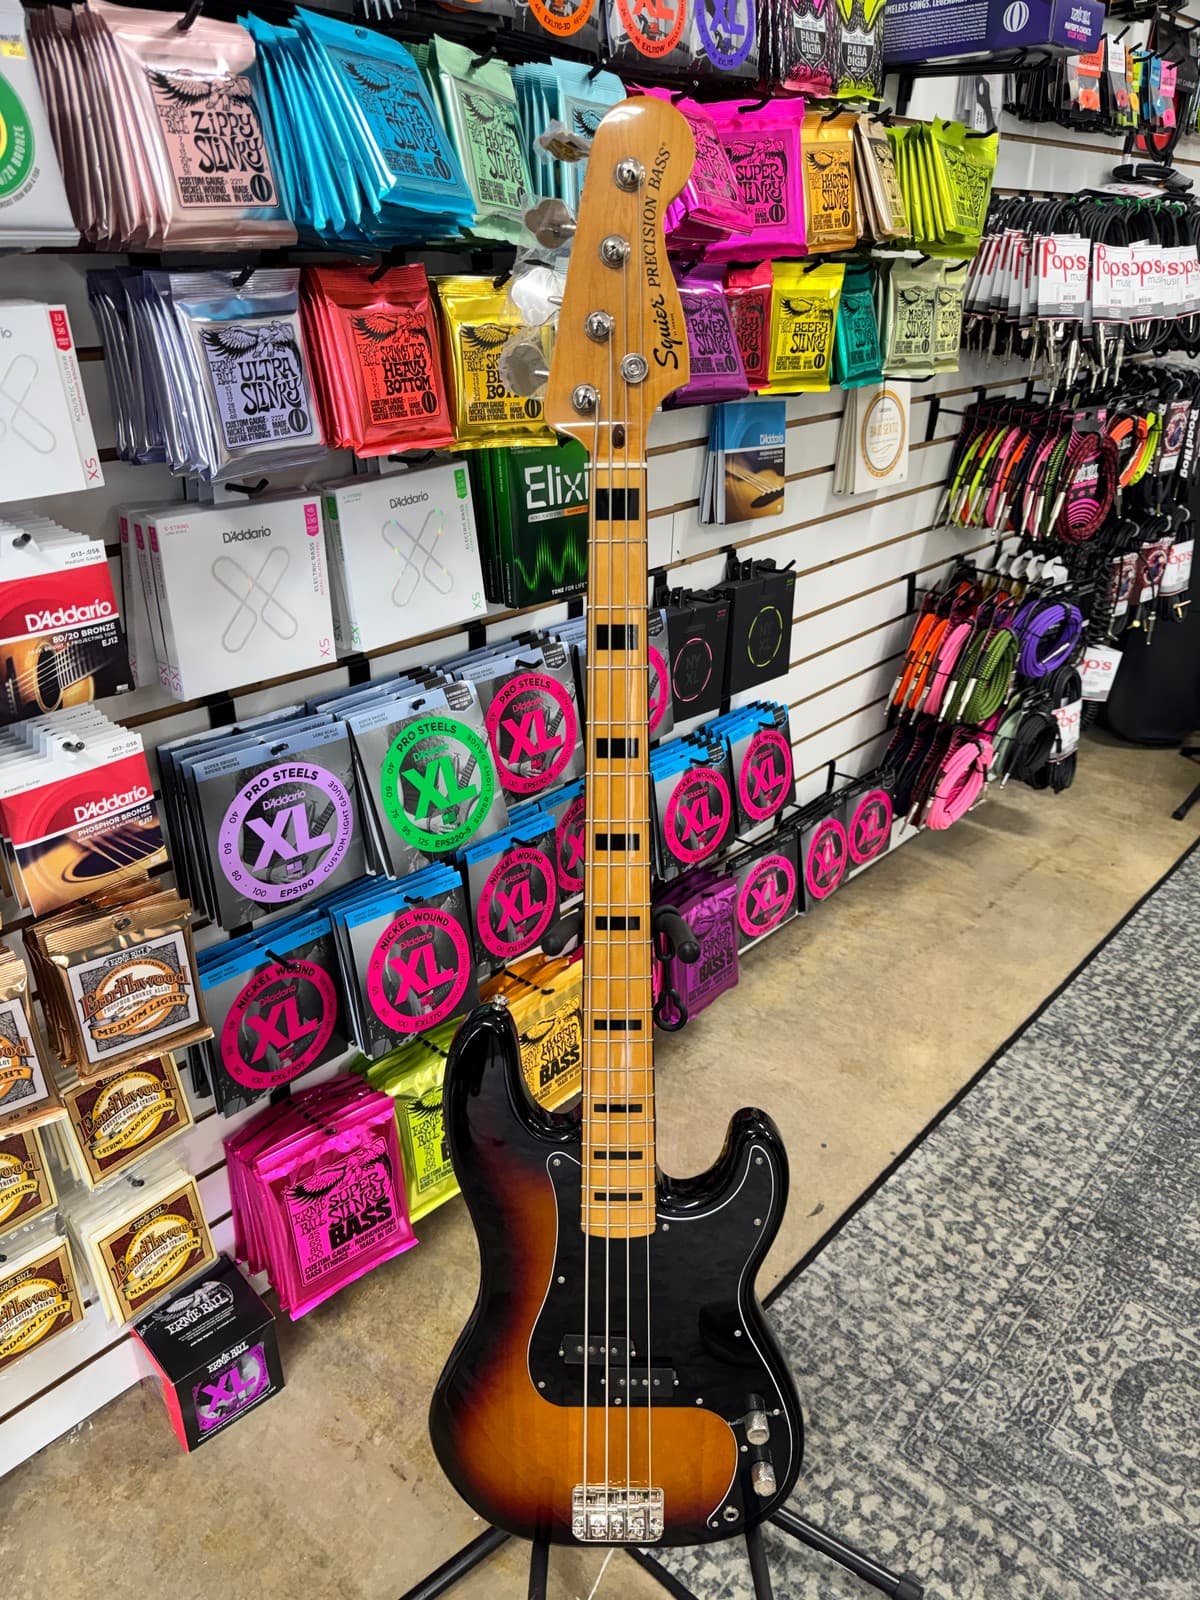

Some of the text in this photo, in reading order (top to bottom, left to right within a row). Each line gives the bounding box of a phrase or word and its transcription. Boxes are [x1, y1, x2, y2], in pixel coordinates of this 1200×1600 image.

[800, 31, 821, 43] PARA
[801, 43, 822, 54] DIGM
[847, 45, 868, 57] PARA
[847, 56, 868, 67] DIGM
[643, 146, 671, 287] PRECISION BASS
[652, 293, 683, 369] Squier
[691, 318, 729, 333] POWER
[793, 322, 828, 333] BEEFY
[410, 343, 425, 360] TOP
[238, 356, 297, 381] ULTRA
[383, 359, 428, 379] HEAVY
[385, 375, 433, 396] BOTTOM
[225, 415, 267, 430] CUSTOM GAUGE
[272, 420, 287, 428] MADE
[84, 457, 100, 481] XS
[389, 490, 429, 510] D'Addario
[222, 525, 272, 544] D'Addario
[312, 563, 320, 593] ELECTRIC
[551, 583, 586, 596] TONE FOR LIFE
[471, 591, 482, 610] XS
[25, 599, 112, 633] D'Addario
[52, 622, 116, 645] 80/20 BRONZE
[101, 637, 119, 649] EJ12
[319, 637, 331, 658] XS
[499, 678, 553, 705] PRO STEELS
[396, 721, 458, 754] PRO STEELS
[501, 708, 562, 766] XL
[243, 767, 319, 801] PRO STEELS
[400, 754, 479, 822] XL
[673, 771, 719, 801] NICKEL WOUND
[751, 756, 785, 800] XL
[73, 786, 148, 823] D'Addario
[261, 789, 306, 811] D'Addario
[77, 803, 152, 837] PHOSPHOR BRONZE
[138, 814, 153, 826] EJ17
[323, 780, 351, 873] CUSTOM LIGHT GAUGE
[679, 795, 722, 842] XL
[858, 810, 884, 849] XL
[244, 802, 333, 874] XL
[434, 825, 472, 849] EPS220-5
[223, 810, 267, 898] 40 60 80 100
[489, 851, 544, 886] NICKEL WOUND
[753, 859, 782, 877] CHROMES
[815, 842, 841, 882] XL
[279, 878, 315, 899] EPS190
[751, 879, 786, 921] XL
[495, 878, 544, 935] XL
[380, 912, 449, 951] NICKEL WOUND
[399, 931, 433, 951] D'Addario
[389, 943, 456, 1007] XL
[79, 964, 192, 1025] Earthwood
[236, 973, 273, 1011] NICKEL
[258, 984, 297, 1008] D'Addario
[97, 994, 187, 1038] MEDIUM LIGHT
[245, 995, 320, 1065] XL
[541, 1023, 578, 1055] HYBRID
[539, 1045, 581, 1088] BASS
[77, 1071, 177, 1146] Earthwood
[123, 1120, 141, 1141] BANJO
[411, 1114, 442, 1137] ERNIE
[417, 1127, 440, 1148] BALL
[328, 1171, 385, 1209] SUPER
[293, 1200, 327, 1226] ERNIE
[300, 1215, 328, 1237] BALL
[328, 1197, 393, 1251] BASS
[111, 1211, 203, 1289] Earthwood
[308, 1230, 320, 1241] 45
[308, 1238, 322, 1248] 65
[129, 1239, 199, 1297] MANDOLIN MEDIUM
[304, 1257, 332, 1275] CUSTOM
[332, 1243, 352, 1261] GAUGE
[305, 1236, 378, 1282] BASS STRINGS MADE
[307, 1252, 324, 1264] 100
[38, 1303, 68, 1323] LIGHT
[164, 1307, 203, 1336] ERNIE
[200, 1293, 230, 1315] BALL
[206, 1340, 251, 1374] ERNIE BALL
[200, 1366, 257, 1414] XL
